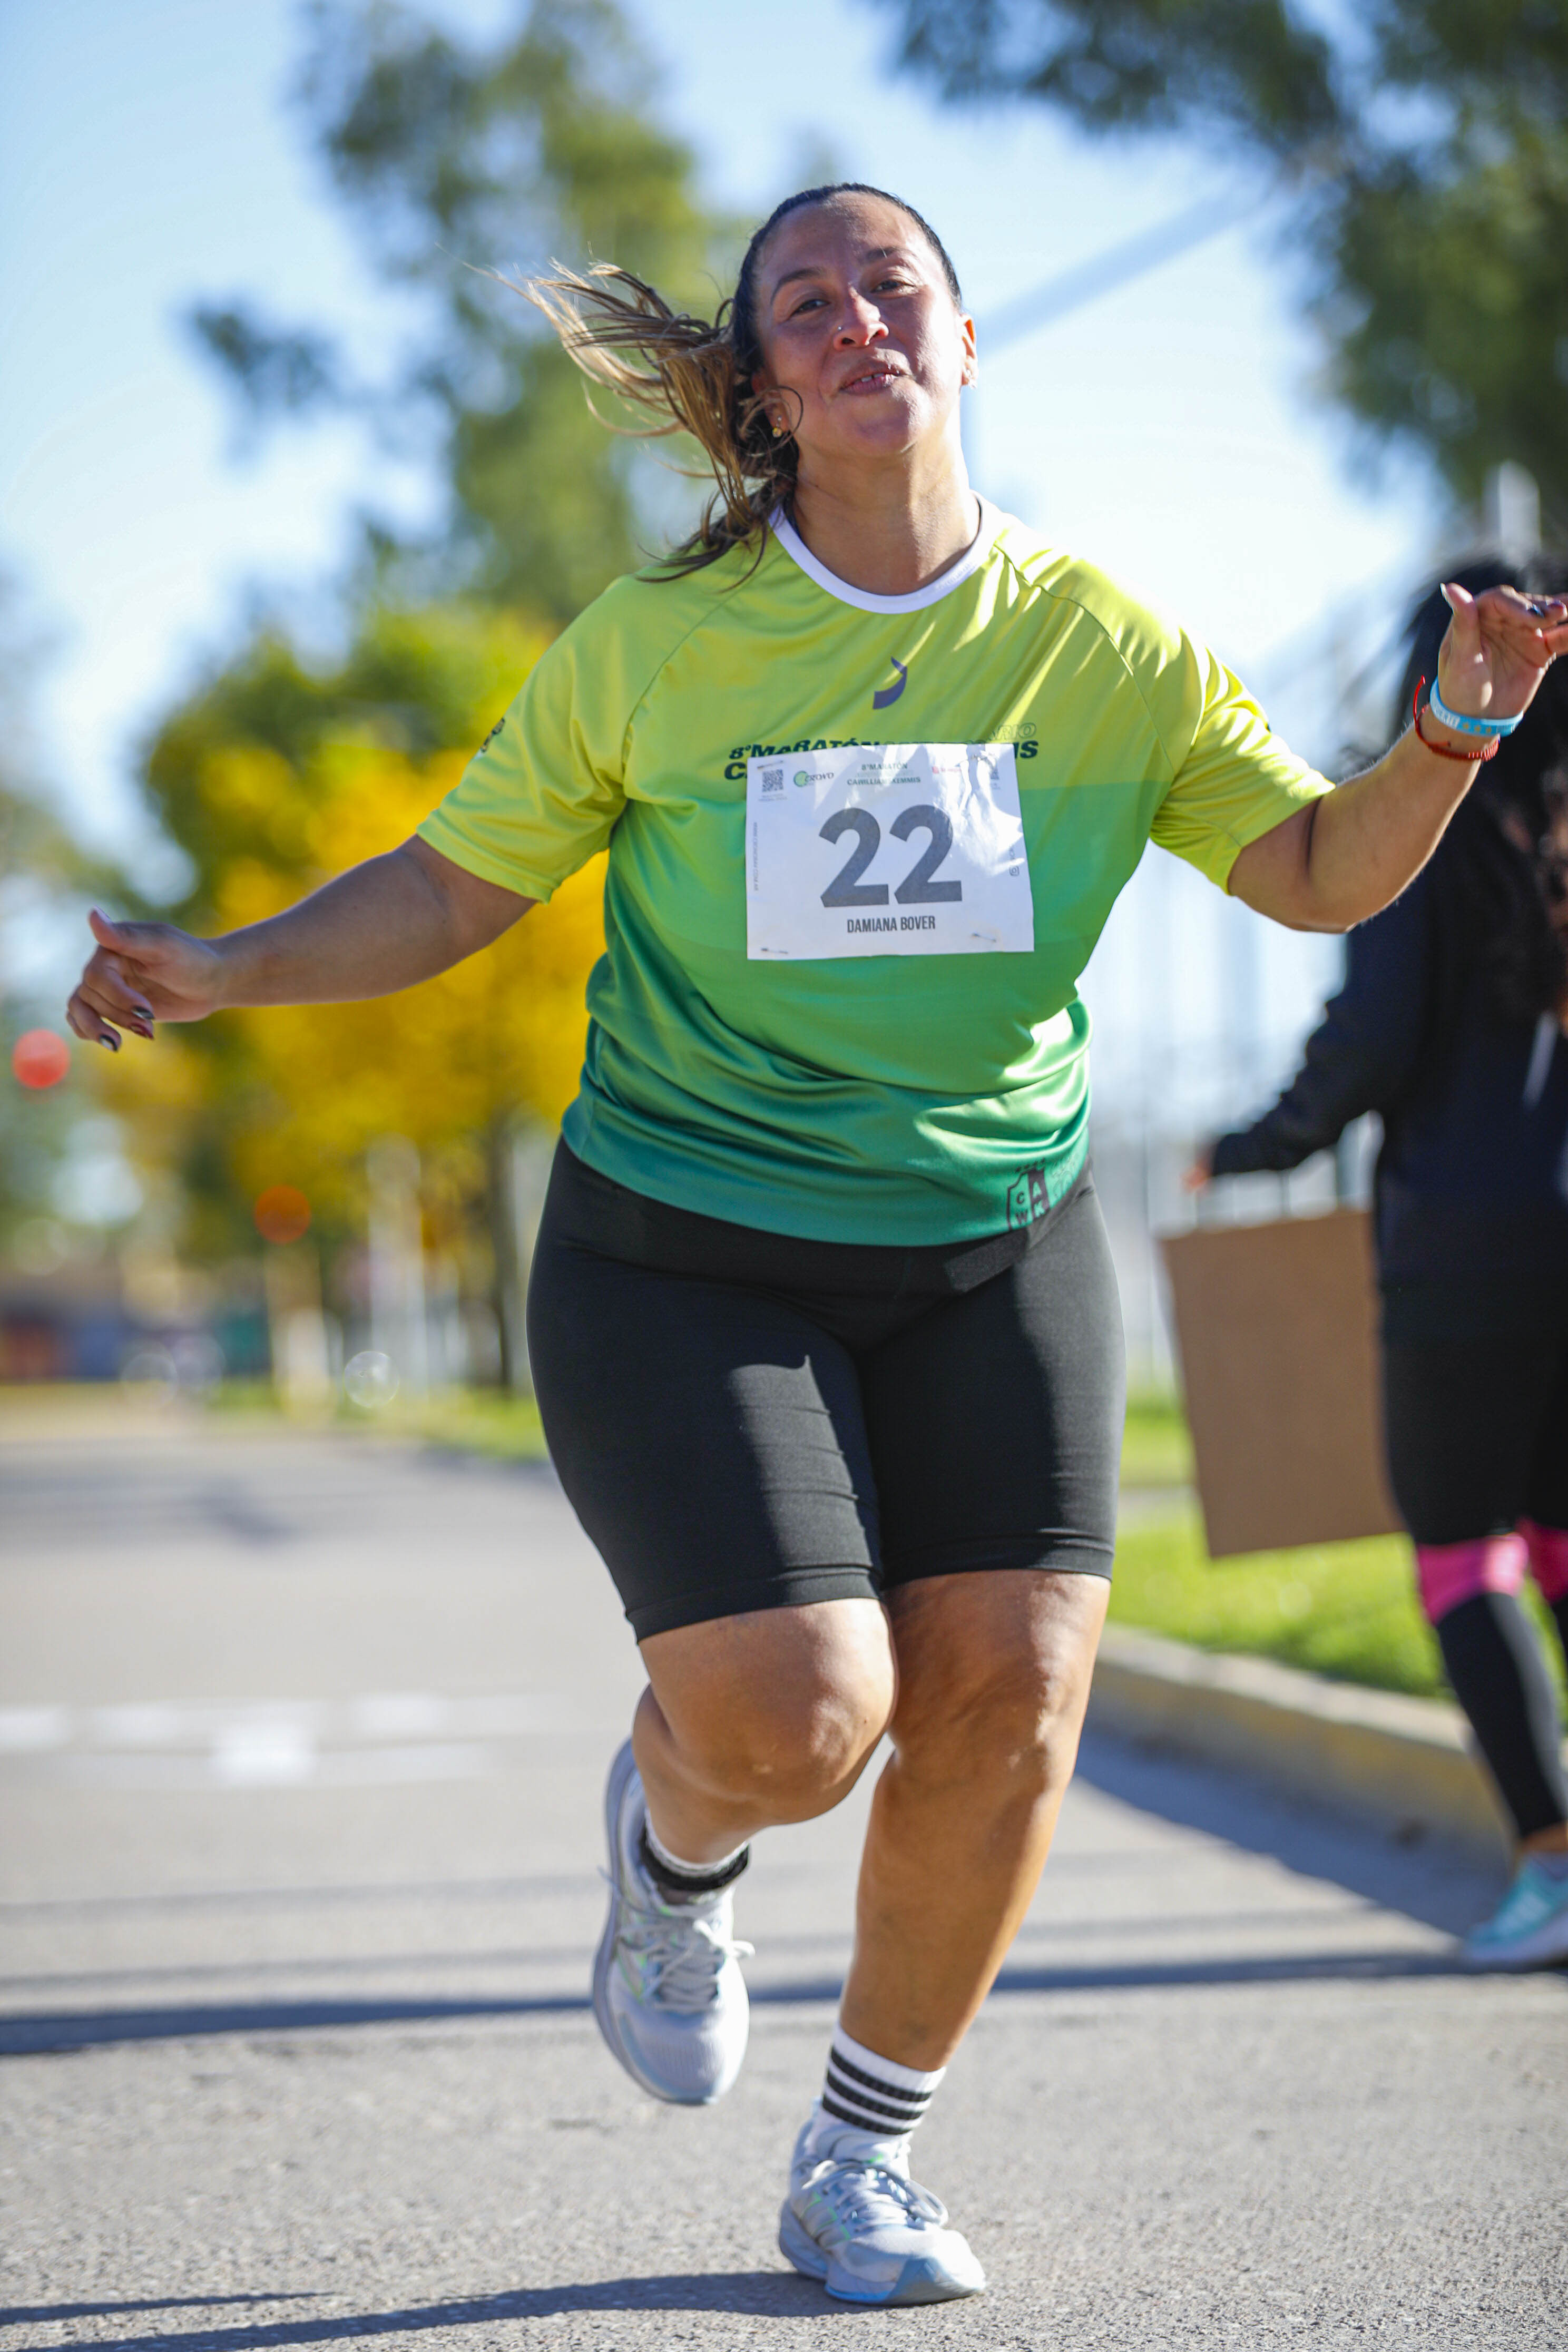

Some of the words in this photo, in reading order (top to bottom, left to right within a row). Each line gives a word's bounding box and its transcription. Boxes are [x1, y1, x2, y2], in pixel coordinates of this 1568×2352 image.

[818, 804, 962, 907] 22
[847, 917, 897, 933] DAMIANA
[900, 915, 936, 930] BOVER
